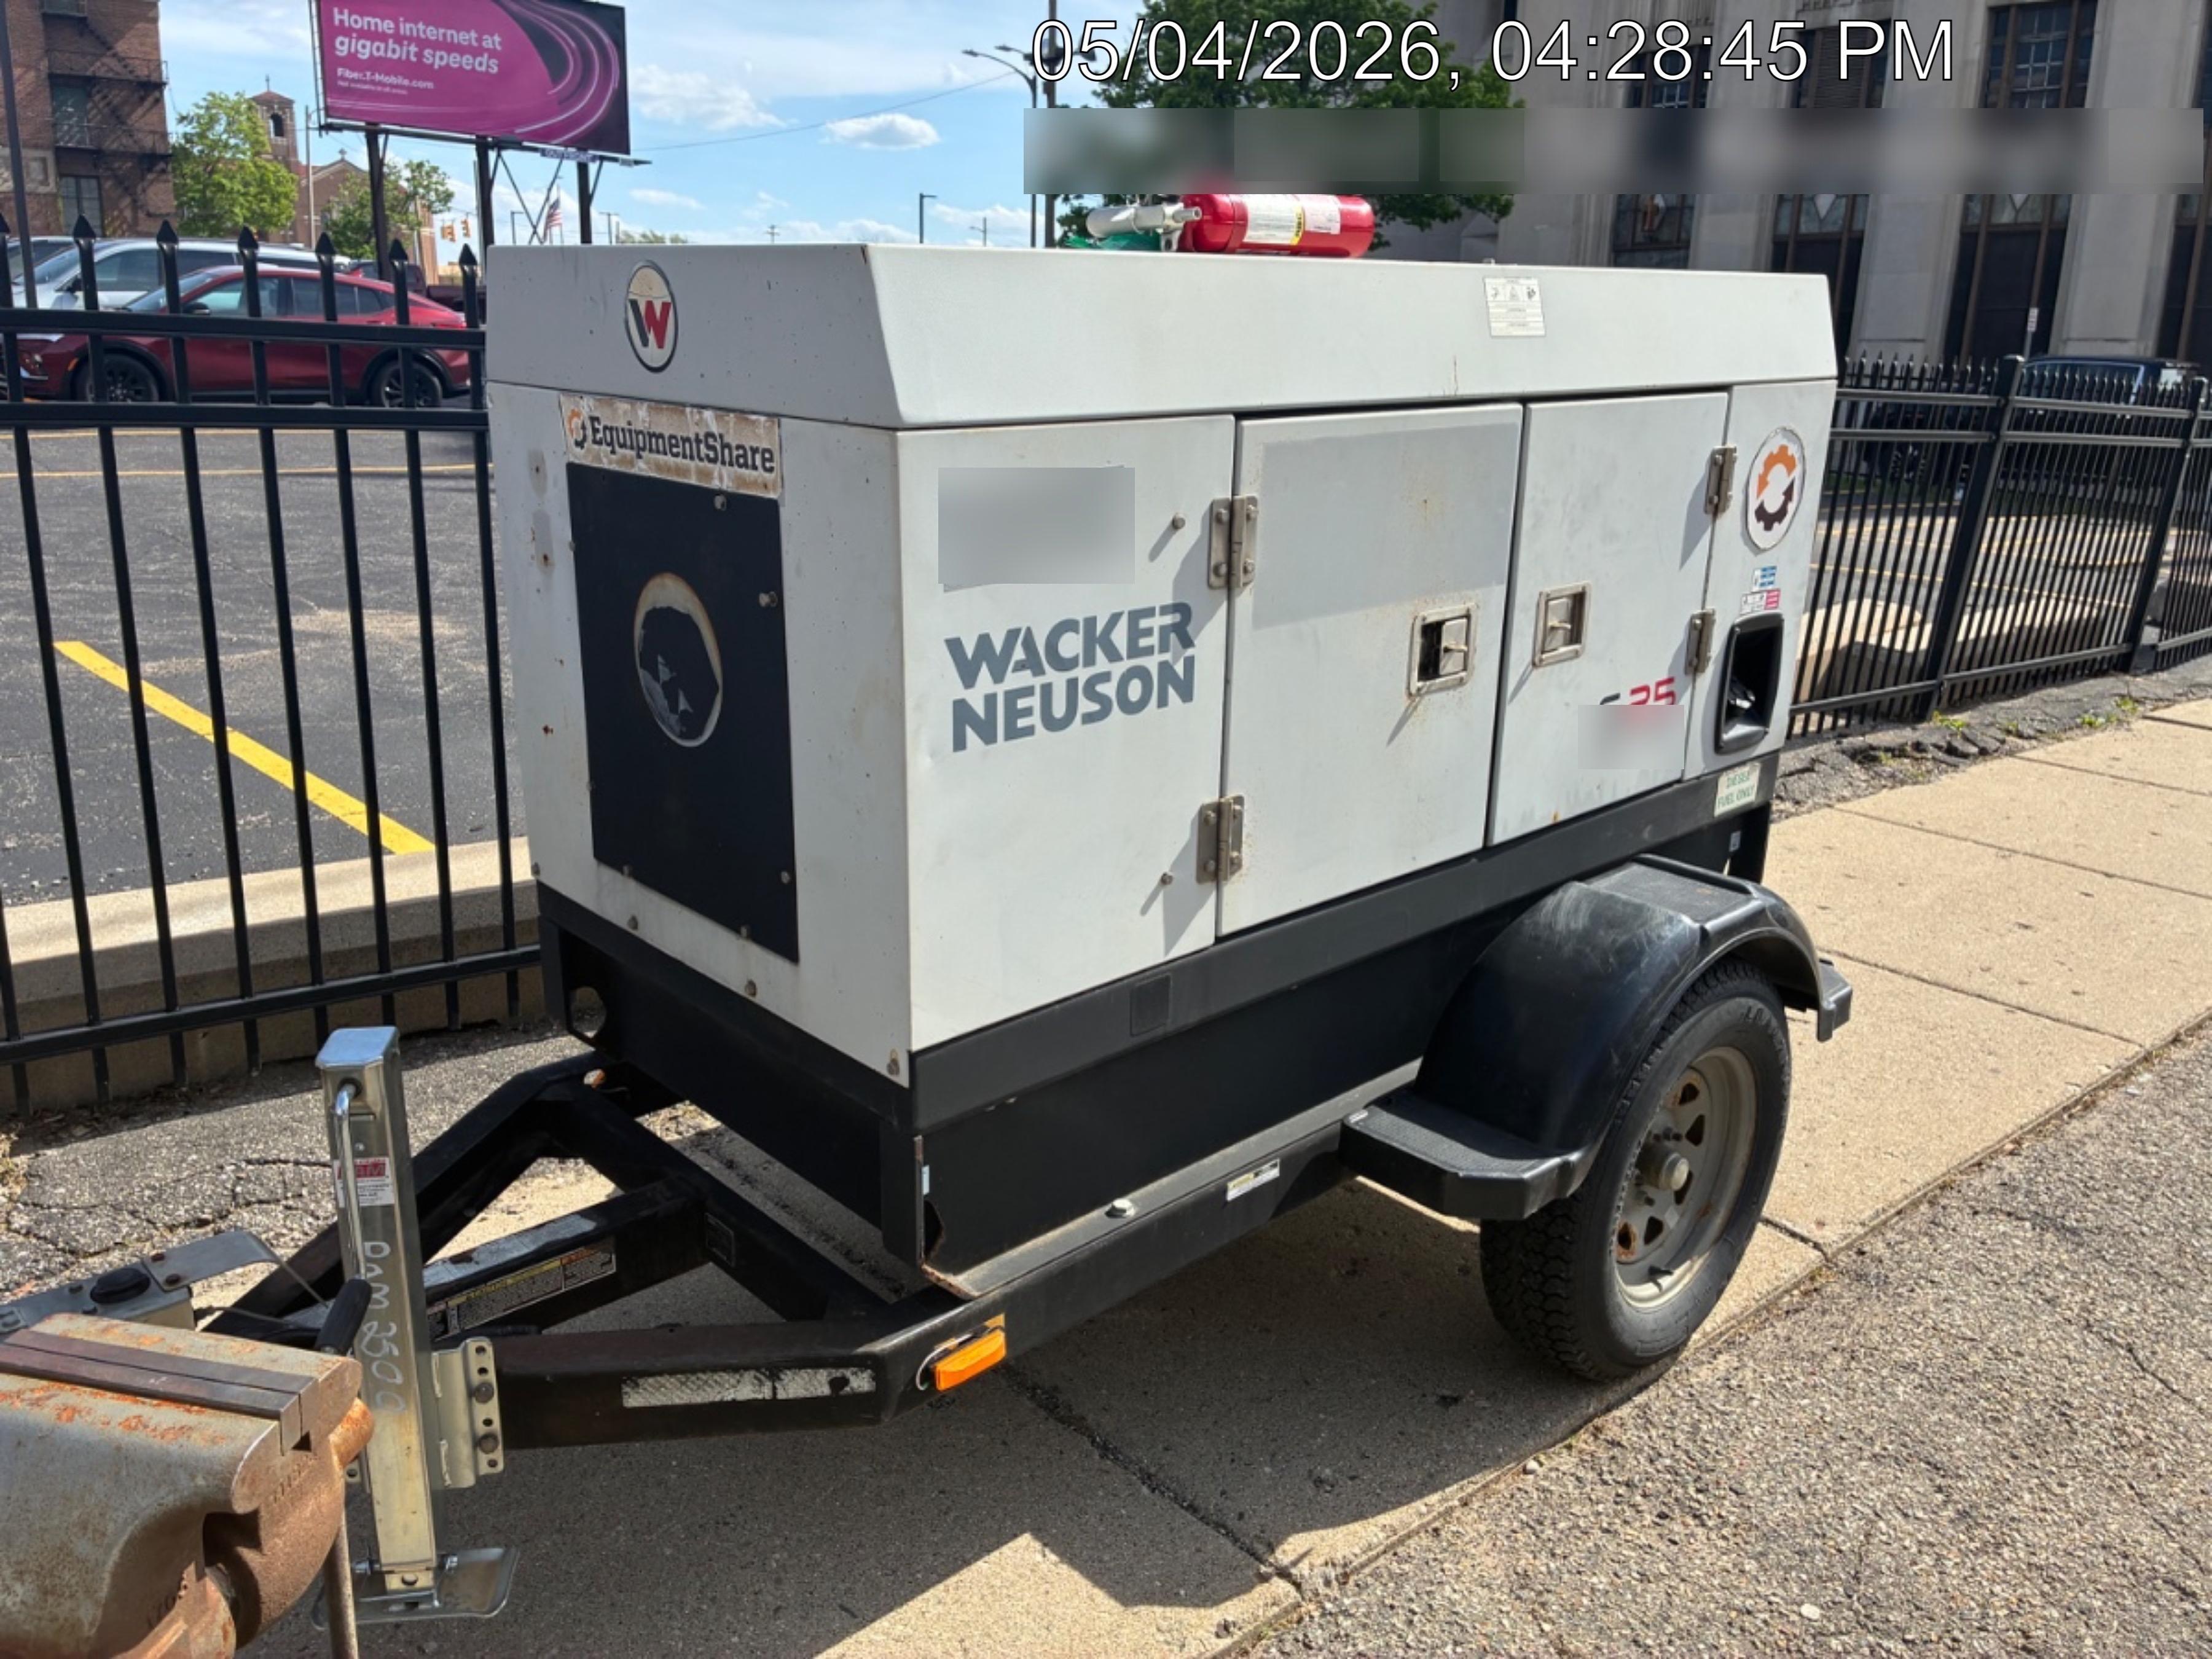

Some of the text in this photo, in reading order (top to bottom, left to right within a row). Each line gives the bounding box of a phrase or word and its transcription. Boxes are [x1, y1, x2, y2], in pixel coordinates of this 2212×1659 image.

[333, 7, 501, 50] Home internet at
[335, 33, 499, 74] gigabit speeds
[628, 299, 672, 349] W
[589, 416, 775, 473] EquipmentShare
[944, 602, 1196, 690] WACKER
[952, 654, 1196, 753] NEUSON
[360, 1320, 406, 1411] 2500
